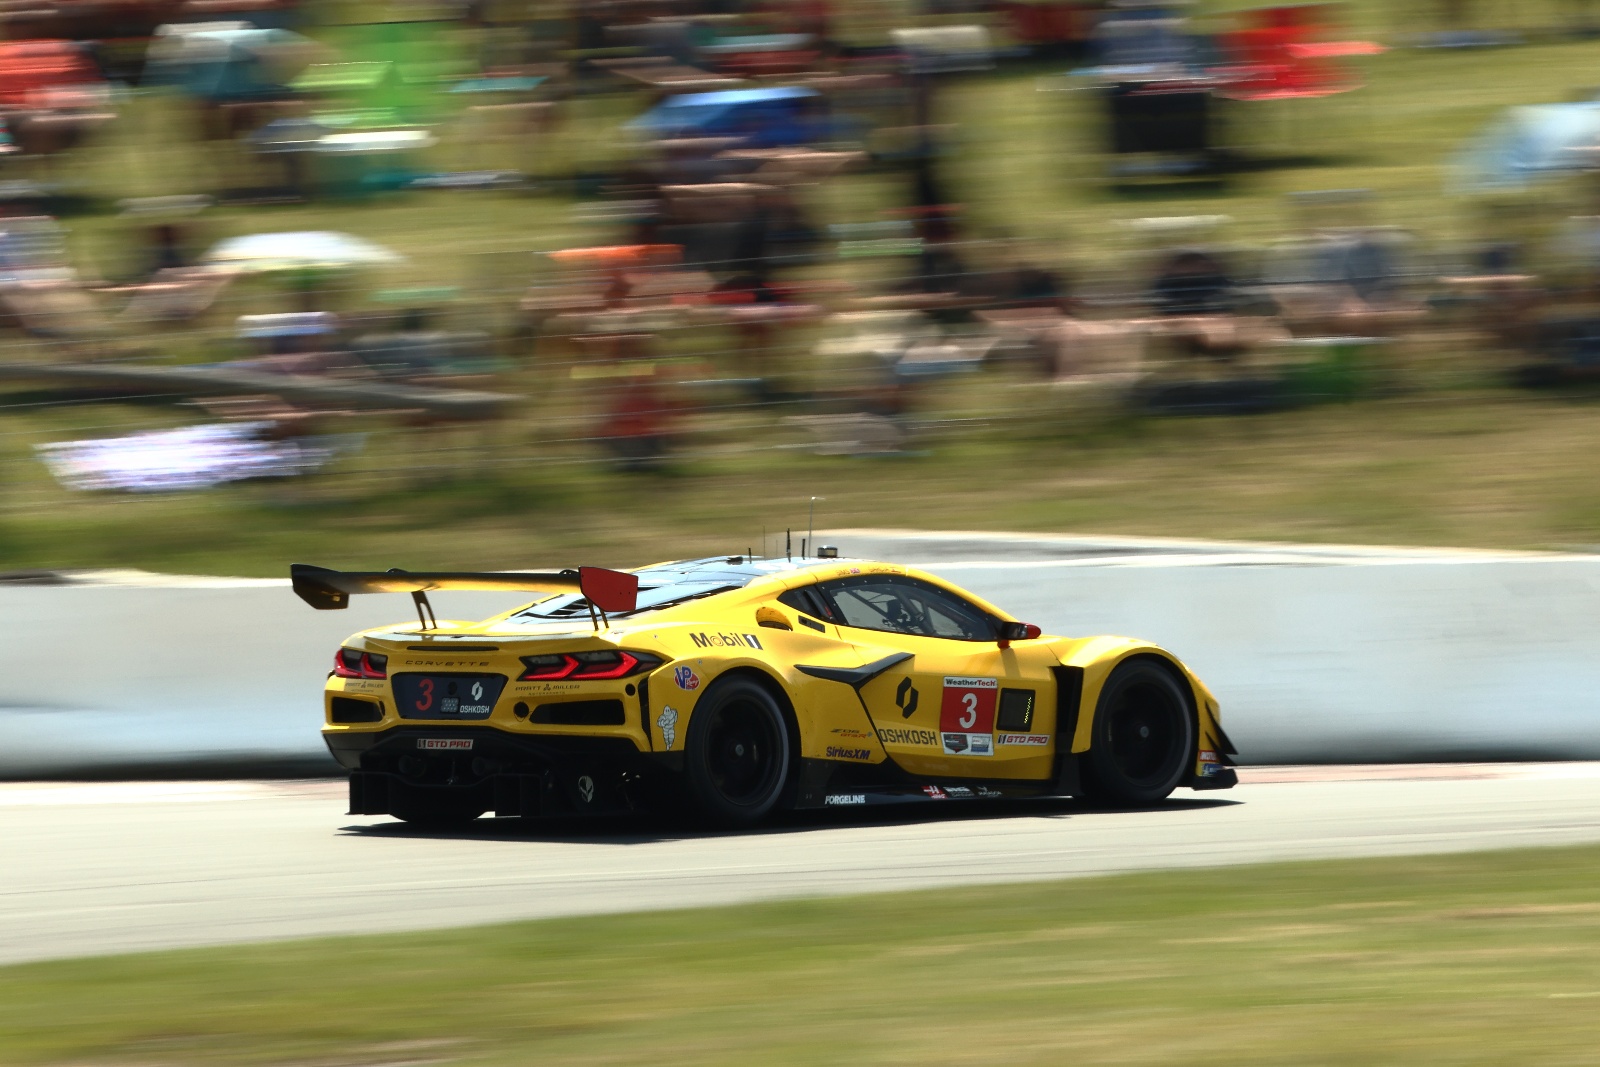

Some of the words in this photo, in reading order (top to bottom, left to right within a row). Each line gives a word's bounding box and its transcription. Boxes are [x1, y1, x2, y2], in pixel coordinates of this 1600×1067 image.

[689, 632, 746, 648] Mobil
[747, 634, 759, 649] 1
[674, 666, 692, 689] VP
[945, 678, 996, 687] WeatherTech
[415, 678, 434, 711] 3
[459, 705, 490, 714] OSHKOSH
[959, 692, 978, 729] 3
[427, 740, 447, 748] GTD
[449, 740, 471, 748] PRO
[877, 728, 938, 746] OSHKOSH
[1005, 735, 1026, 744] GTD
[1028, 736, 1048, 744] PRO
[825, 745, 871, 760] SiriusXM
[825, 794, 866, 805] FORGELINE
